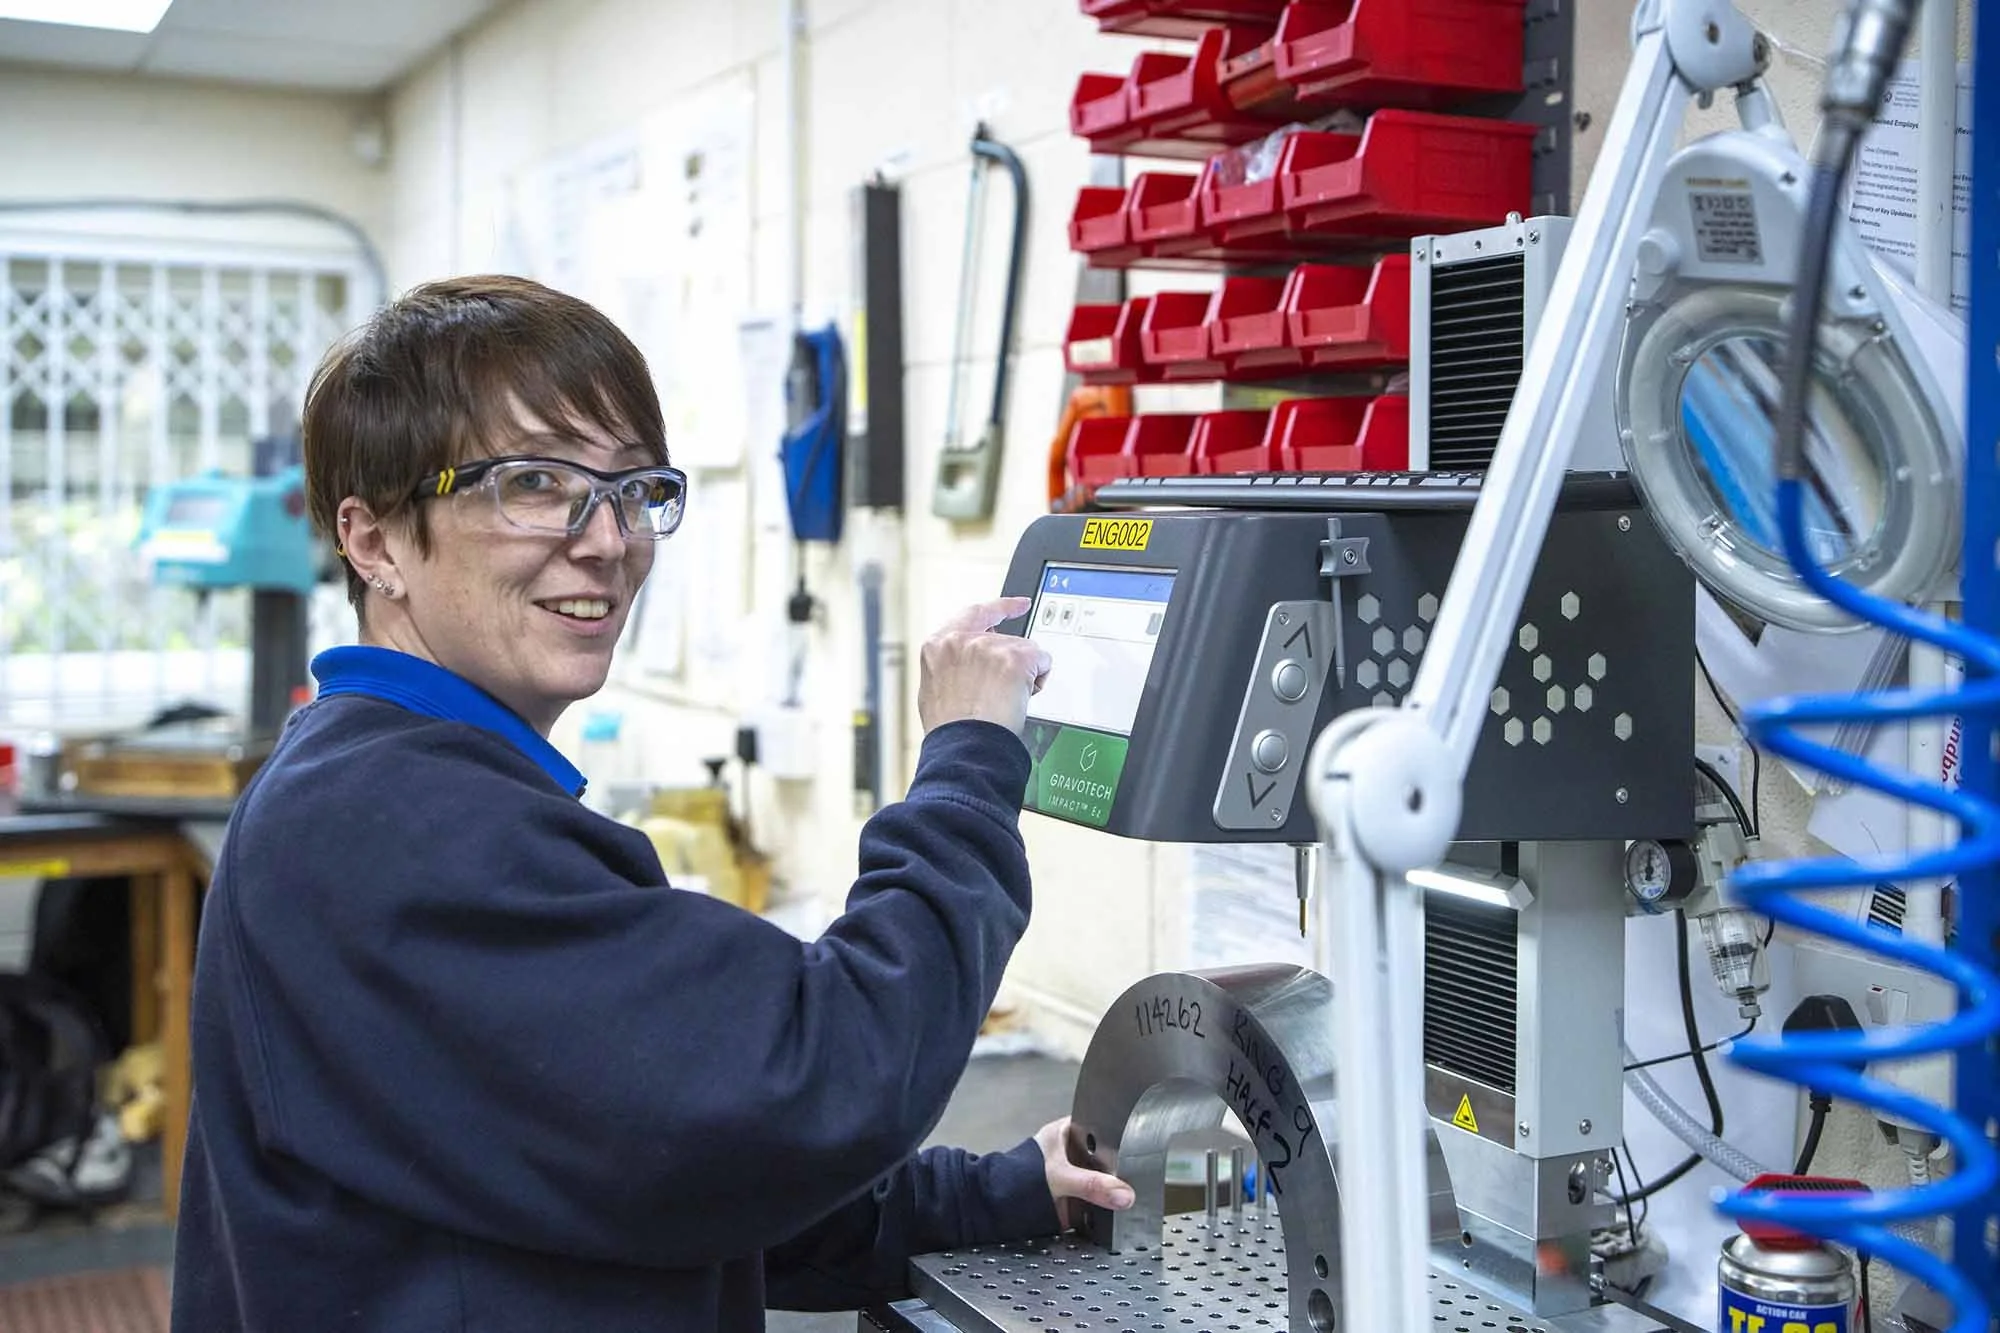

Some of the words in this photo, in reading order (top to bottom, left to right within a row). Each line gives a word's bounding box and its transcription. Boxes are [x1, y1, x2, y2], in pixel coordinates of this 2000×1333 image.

[1880, 207, 1890, 216] Key
[1890, 209, 1913, 219] Updates
[1083, 522, 1149, 547] ENG002
[1050, 774, 1113, 800] GRAVOTECH
[1134, 994, 1206, 1039] 114262
[1232, 1008, 1285, 1097] RING
[1293, 1105, 1314, 1158] 9
[1226, 1060, 1274, 1136] HALF
[1266, 1131, 1293, 1195] 2
[1756, 1304, 1788, 1319] ACTION
[1788, 1309, 1808, 1320] CAN
